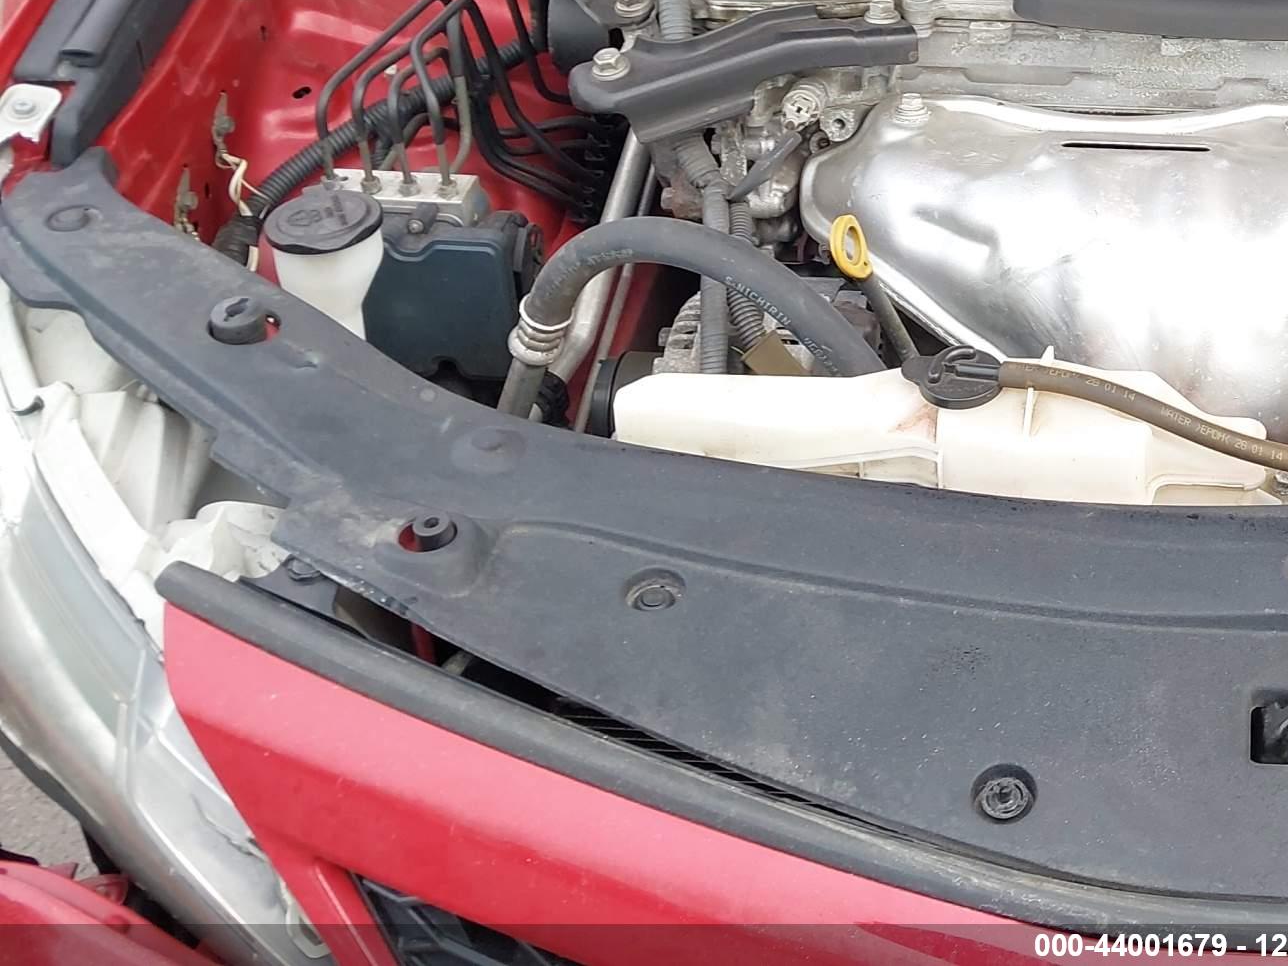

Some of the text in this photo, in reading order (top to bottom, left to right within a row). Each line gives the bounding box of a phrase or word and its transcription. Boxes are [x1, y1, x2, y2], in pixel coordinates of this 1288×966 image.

[1123, 390, 1136, 402] 14
[1160, 407, 1192, 427] WATER
[1271, 449, 1283, 462] 14
